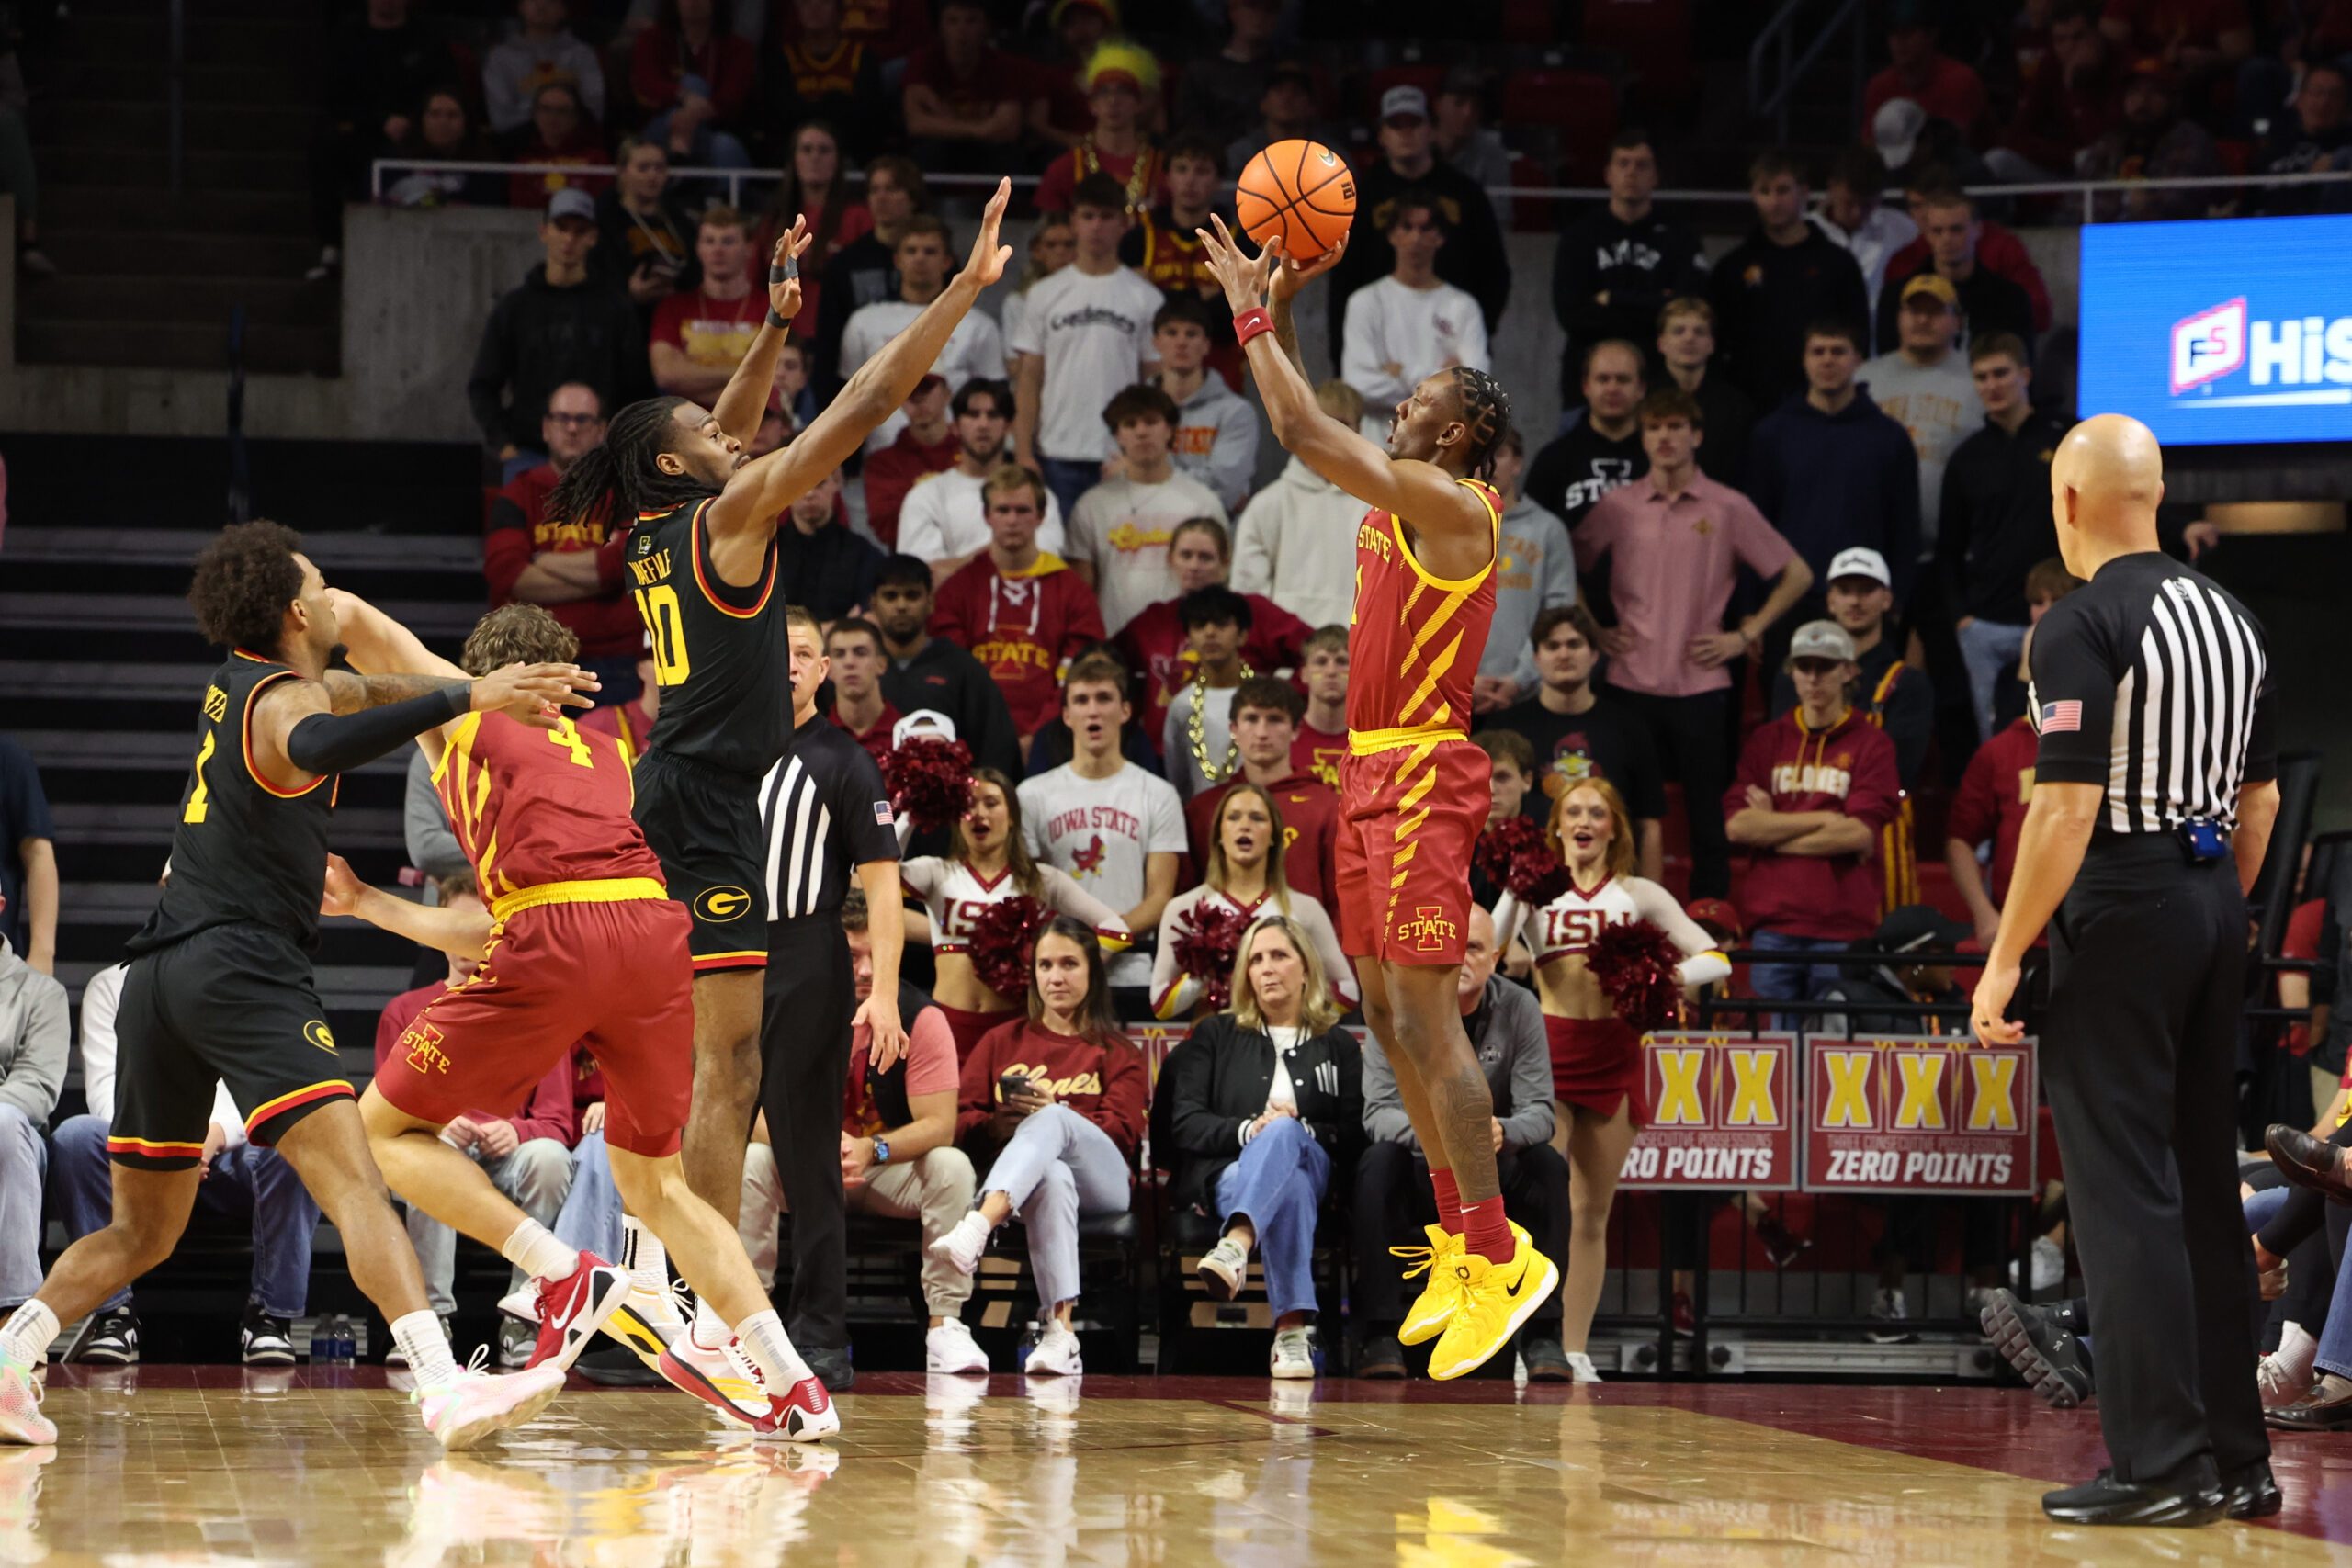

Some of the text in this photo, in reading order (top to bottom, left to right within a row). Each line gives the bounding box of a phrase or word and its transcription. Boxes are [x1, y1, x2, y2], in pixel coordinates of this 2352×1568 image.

[1358, 525, 1392, 563] STATE
[634, 584, 690, 686] 10
[971, 641, 1049, 670] STATE
[547, 715, 594, 769] 4
[184, 728, 215, 822] 1
[1048, 806, 1140, 843] IOWA STATE
[941, 897, 990, 937] IS
[1398, 919, 1456, 941] STATE
[403, 1031, 450, 1074] STATE
[1634, 1132, 1694, 1147] NSECUTIVE
[1620, 1146, 1774, 1179] RO POINTS
[1826, 1149, 2014, 1185] ZERO POINTS
